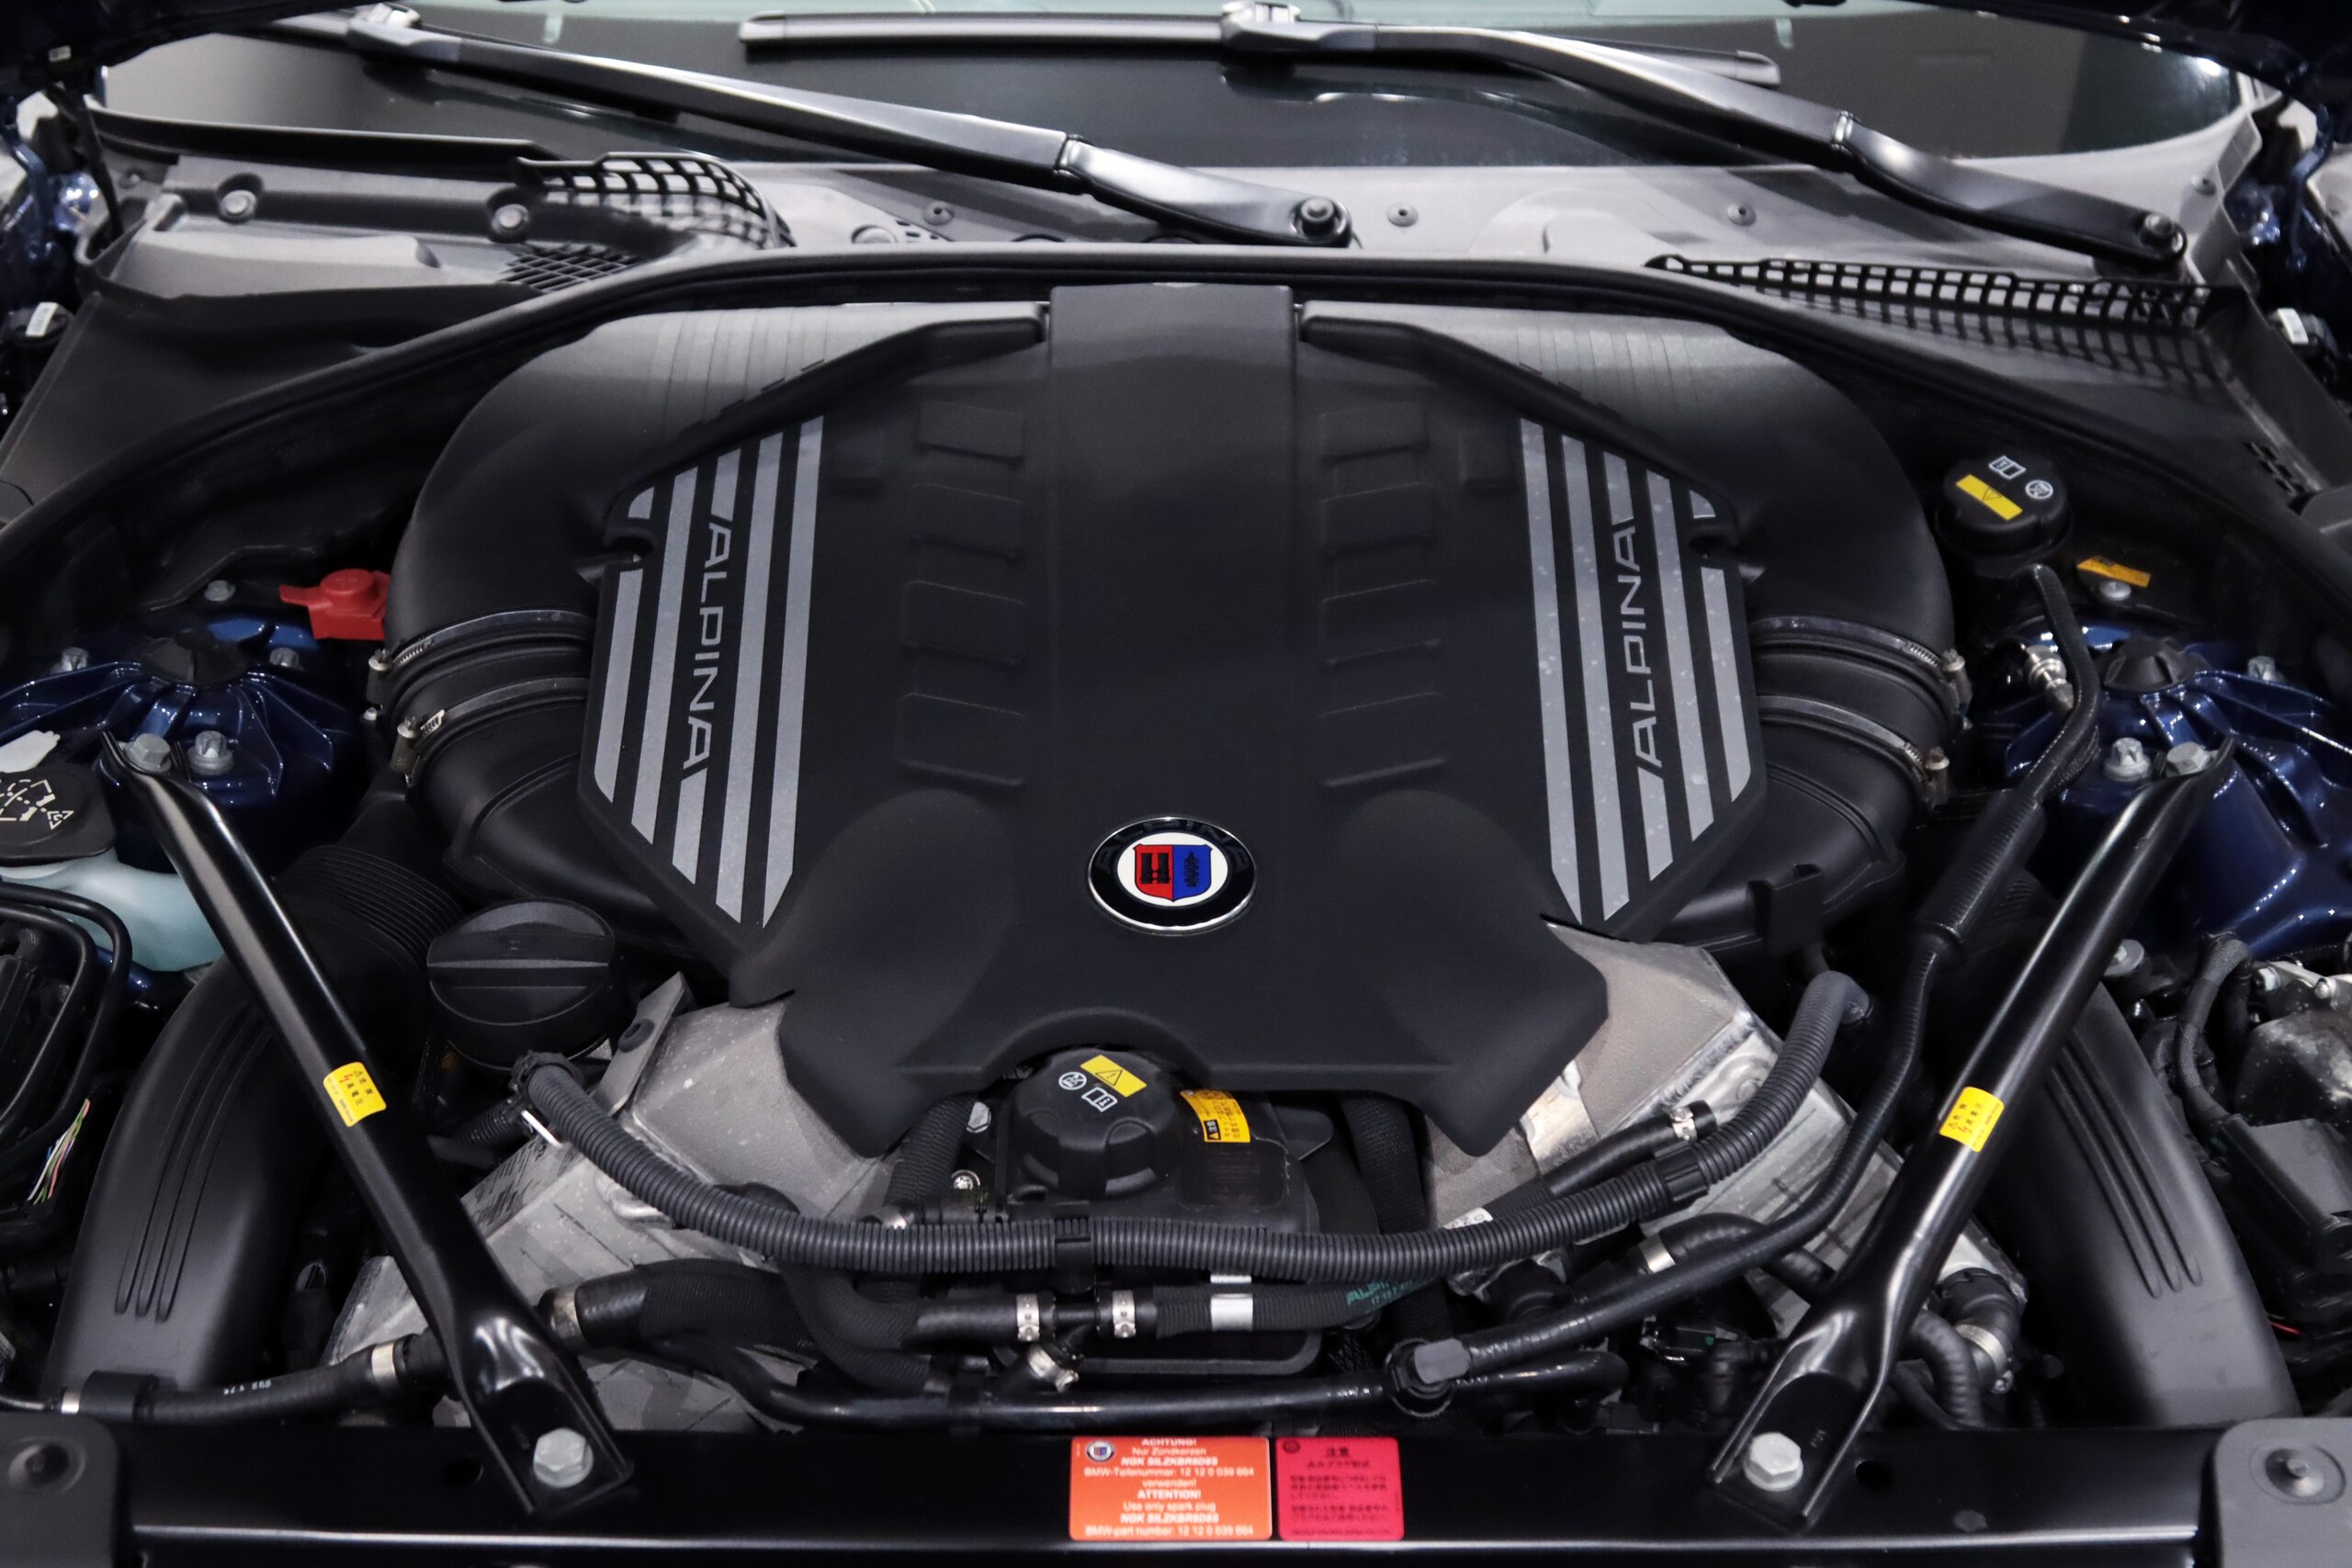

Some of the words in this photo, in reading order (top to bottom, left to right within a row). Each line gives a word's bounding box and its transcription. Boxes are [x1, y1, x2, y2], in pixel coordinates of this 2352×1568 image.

[684, 522, 731, 770] ALPINA
[1612, 525, 1664, 767] ALPINA
[1132, 1447, 1149, 1456] Nur
[1121, 1457, 1145, 1466] NGK
[1180, 1467, 1192, 1477] 12
[1194, 1467, 1206, 1477] 12
[1207, 1467, 1215, 1477] 0
[1141, 1478, 1197, 1488] verwenden!
[1137, 1489, 1202, 1499] ATTENTION!
[1123, 1501, 1143, 1511] Use
[1145, 1501, 1165, 1513] only
[1166, 1501, 1193, 1513] spark
[1194, 1501, 1216, 1513] plug
[1121, 1513, 1145, 1523] NGK
[1084, 1525, 1134, 1538] BMW-part
[1178, 1525, 1190, 1536] 12
[1193, 1525, 1204, 1536] 12
